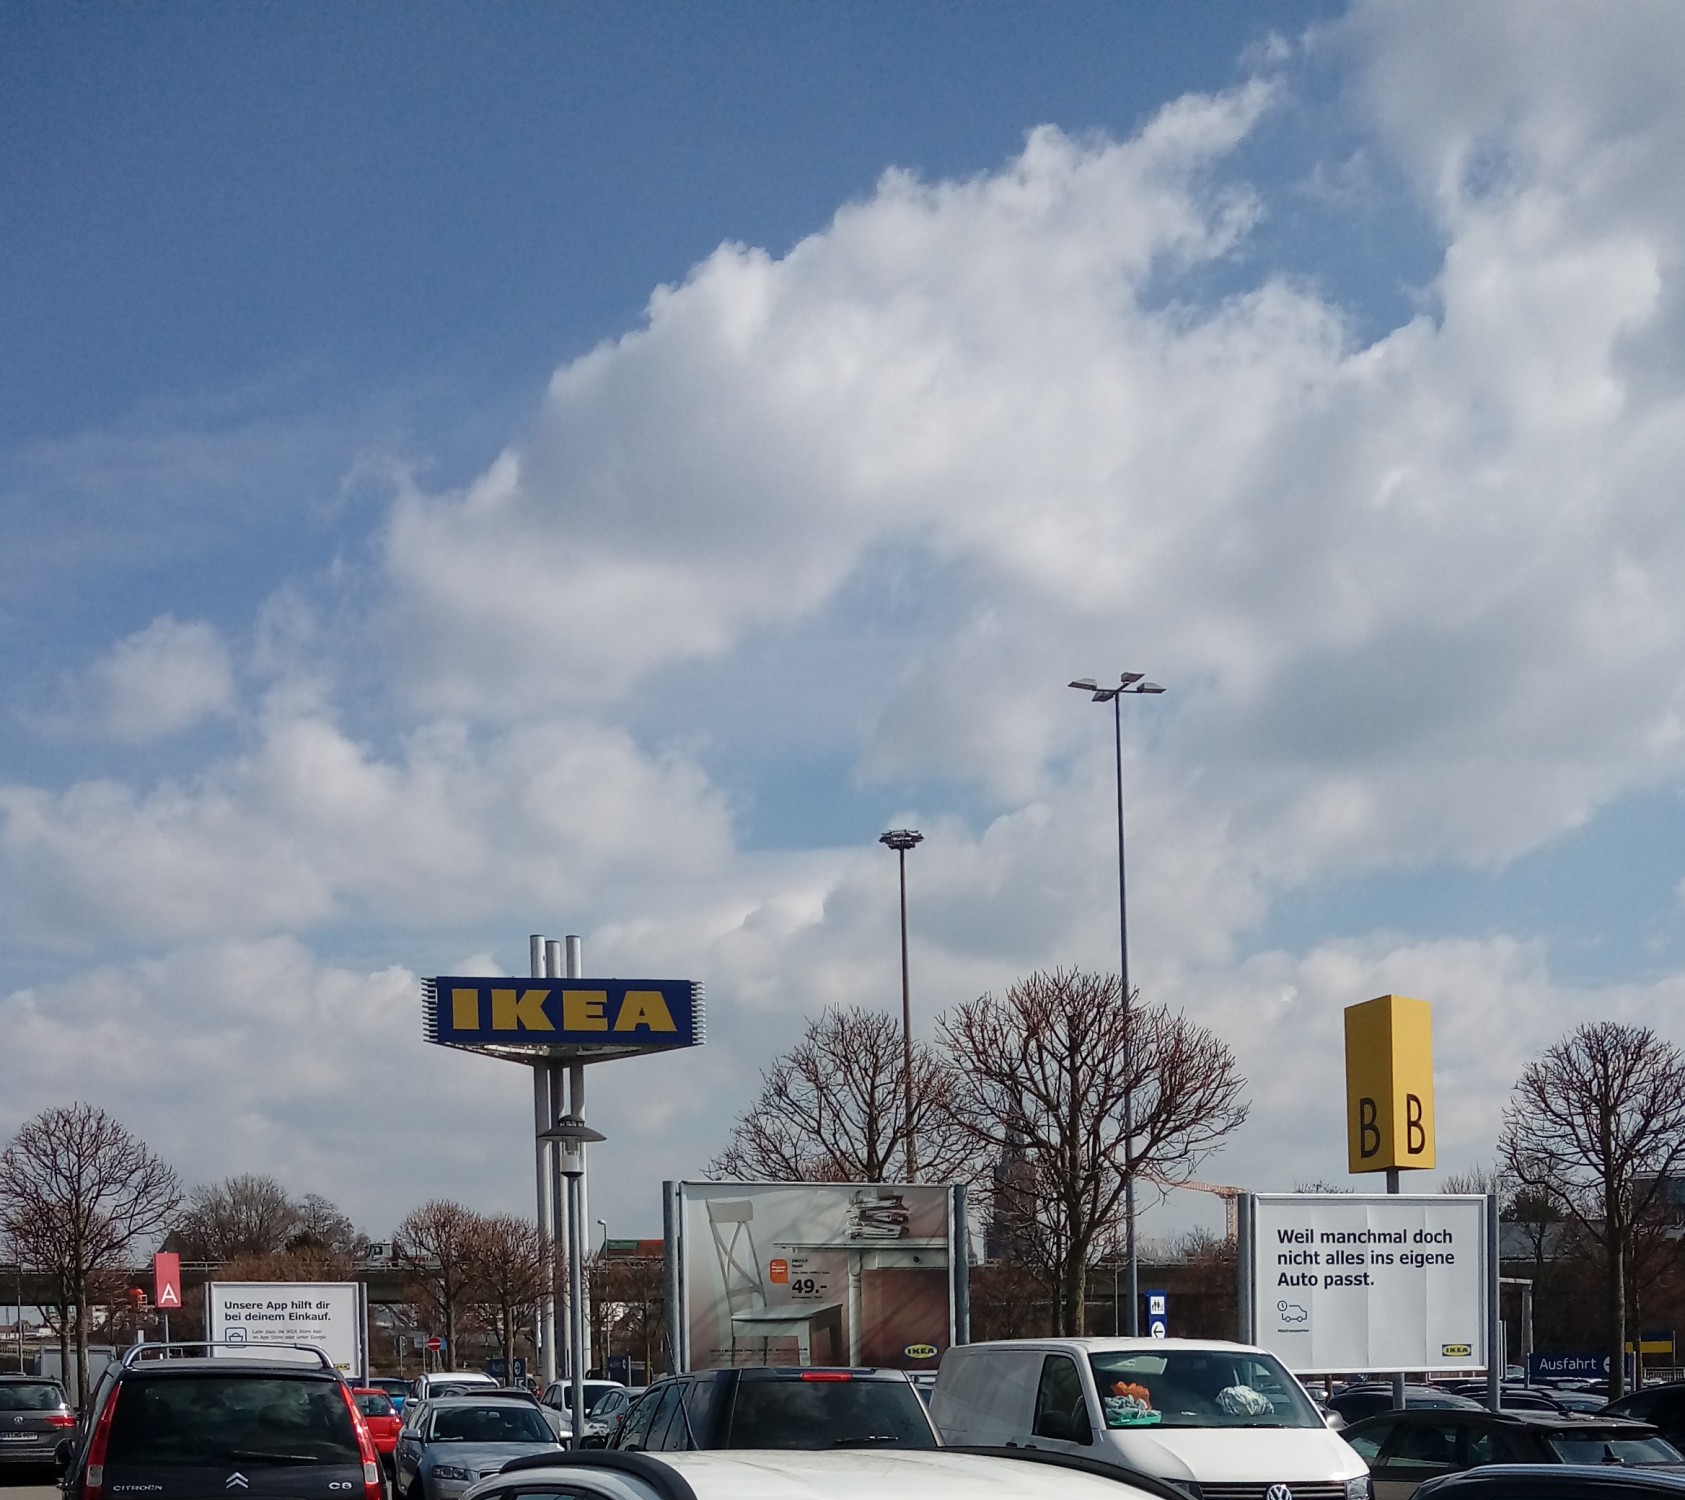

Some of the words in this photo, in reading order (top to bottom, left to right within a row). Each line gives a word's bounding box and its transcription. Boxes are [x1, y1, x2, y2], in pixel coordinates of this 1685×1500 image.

[452, 988, 678, 1032] IKEA
[1359, 1097, 1381, 1159] B
[1406, 1093, 1426, 1155] B
[1277, 1229, 1314, 1244] Weil
[1320, 1229, 1407, 1244] manchmal
[1413, 1229, 1453, 1244] doch
[1277, 1250, 1321, 1265] nicht
[1325, 1250, 1365, 1265] alles
[1370, 1250, 1394, 1265] ins
[1399, 1250, 1455, 1268] eigene
[791, 1279, 827, 1293] 49.-
[1277, 1272, 1318, 1286] Auto
[1323, 1272, 1375, 1289] passt.
[160, 1283, 179, 1304] A
[224, 1301, 263, 1310] Unsere
[266, 1301, 288, 1312] App
[291, 1301, 313, 1310] hilft
[315, 1301, 331, 1310] dir
[224, 1312, 242, 1321] bei
[245, 1312, 285, 1321] deinem
[288, 1312, 331, 1321] Einkauf.
[907, 1347, 935, 1355] IKEA
[1539, 1358, 1597, 1370] Ausfahrt
[328, 1481, 352, 1490] C8
